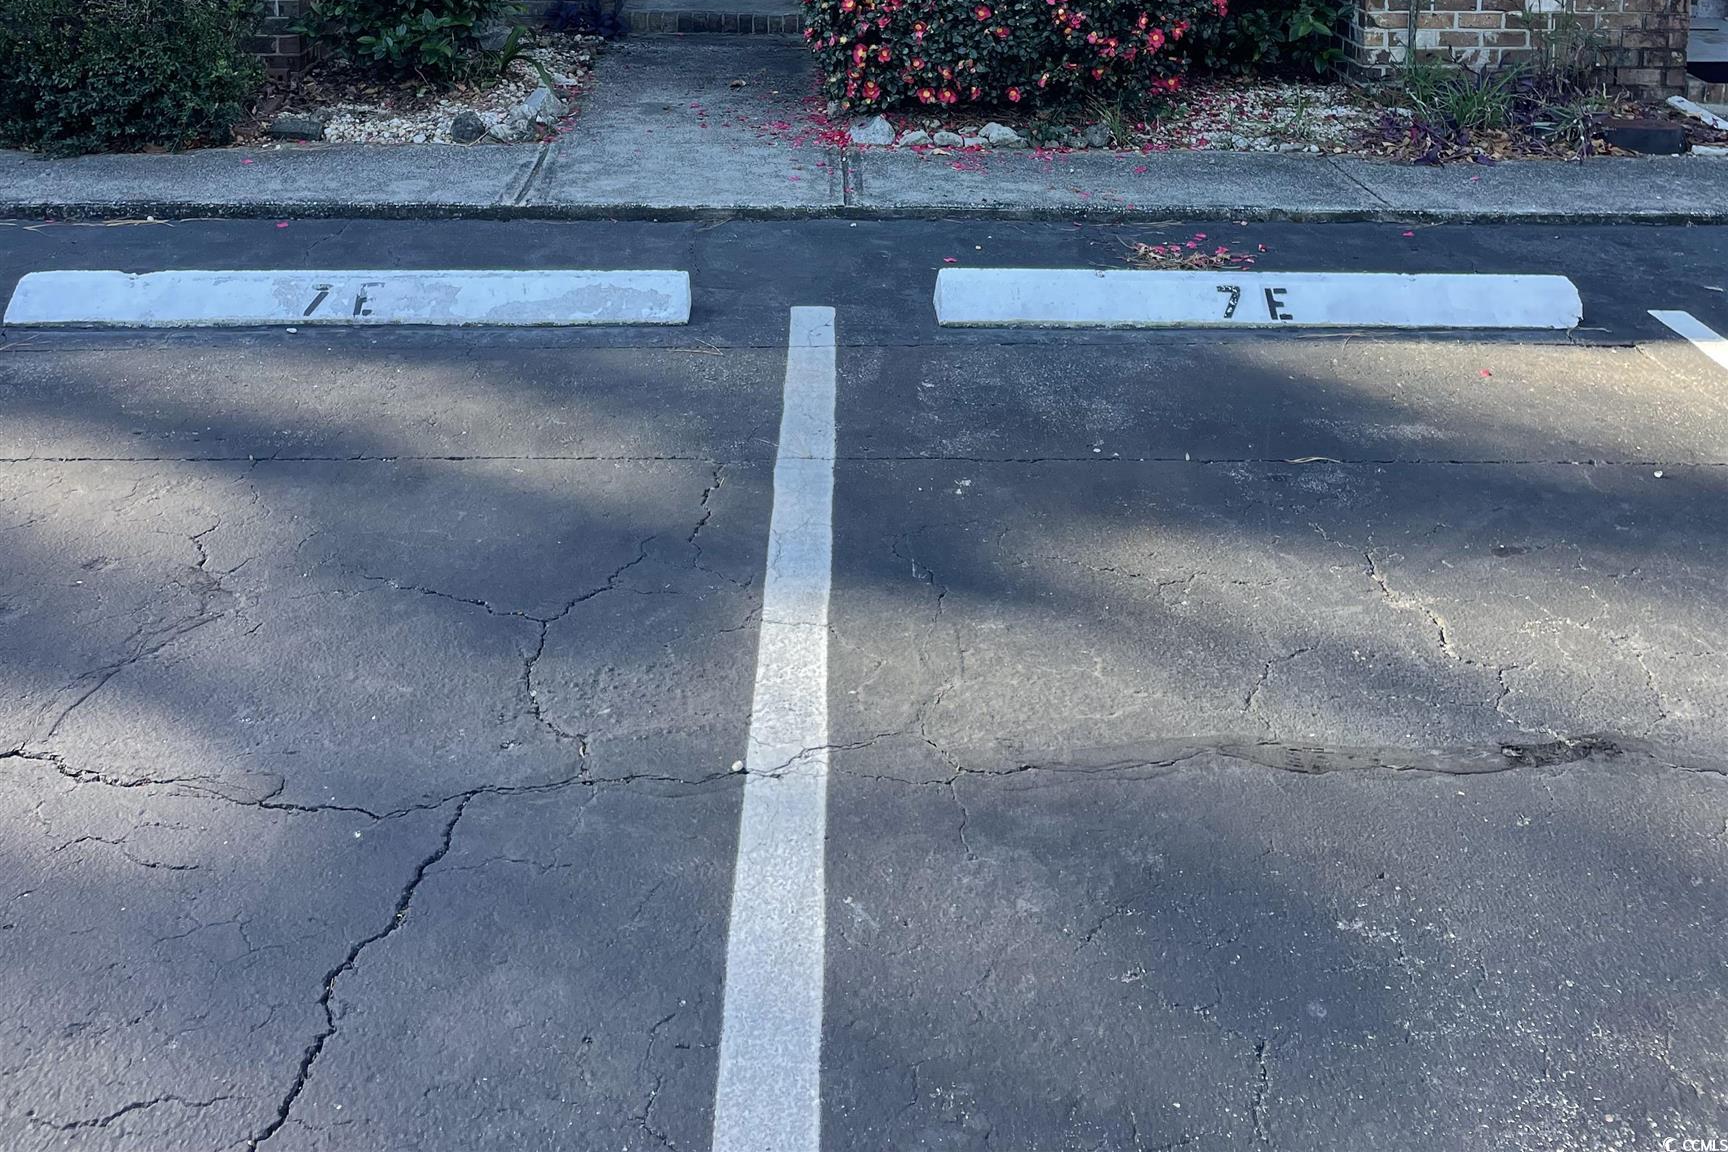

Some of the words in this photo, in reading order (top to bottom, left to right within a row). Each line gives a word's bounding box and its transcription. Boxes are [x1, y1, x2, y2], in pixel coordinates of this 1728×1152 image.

[303, 283, 334, 316] 7
[352, 281, 386, 317] E
[1216, 285, 1241, 319] 7
[1264, 287, 1293, 320] E
